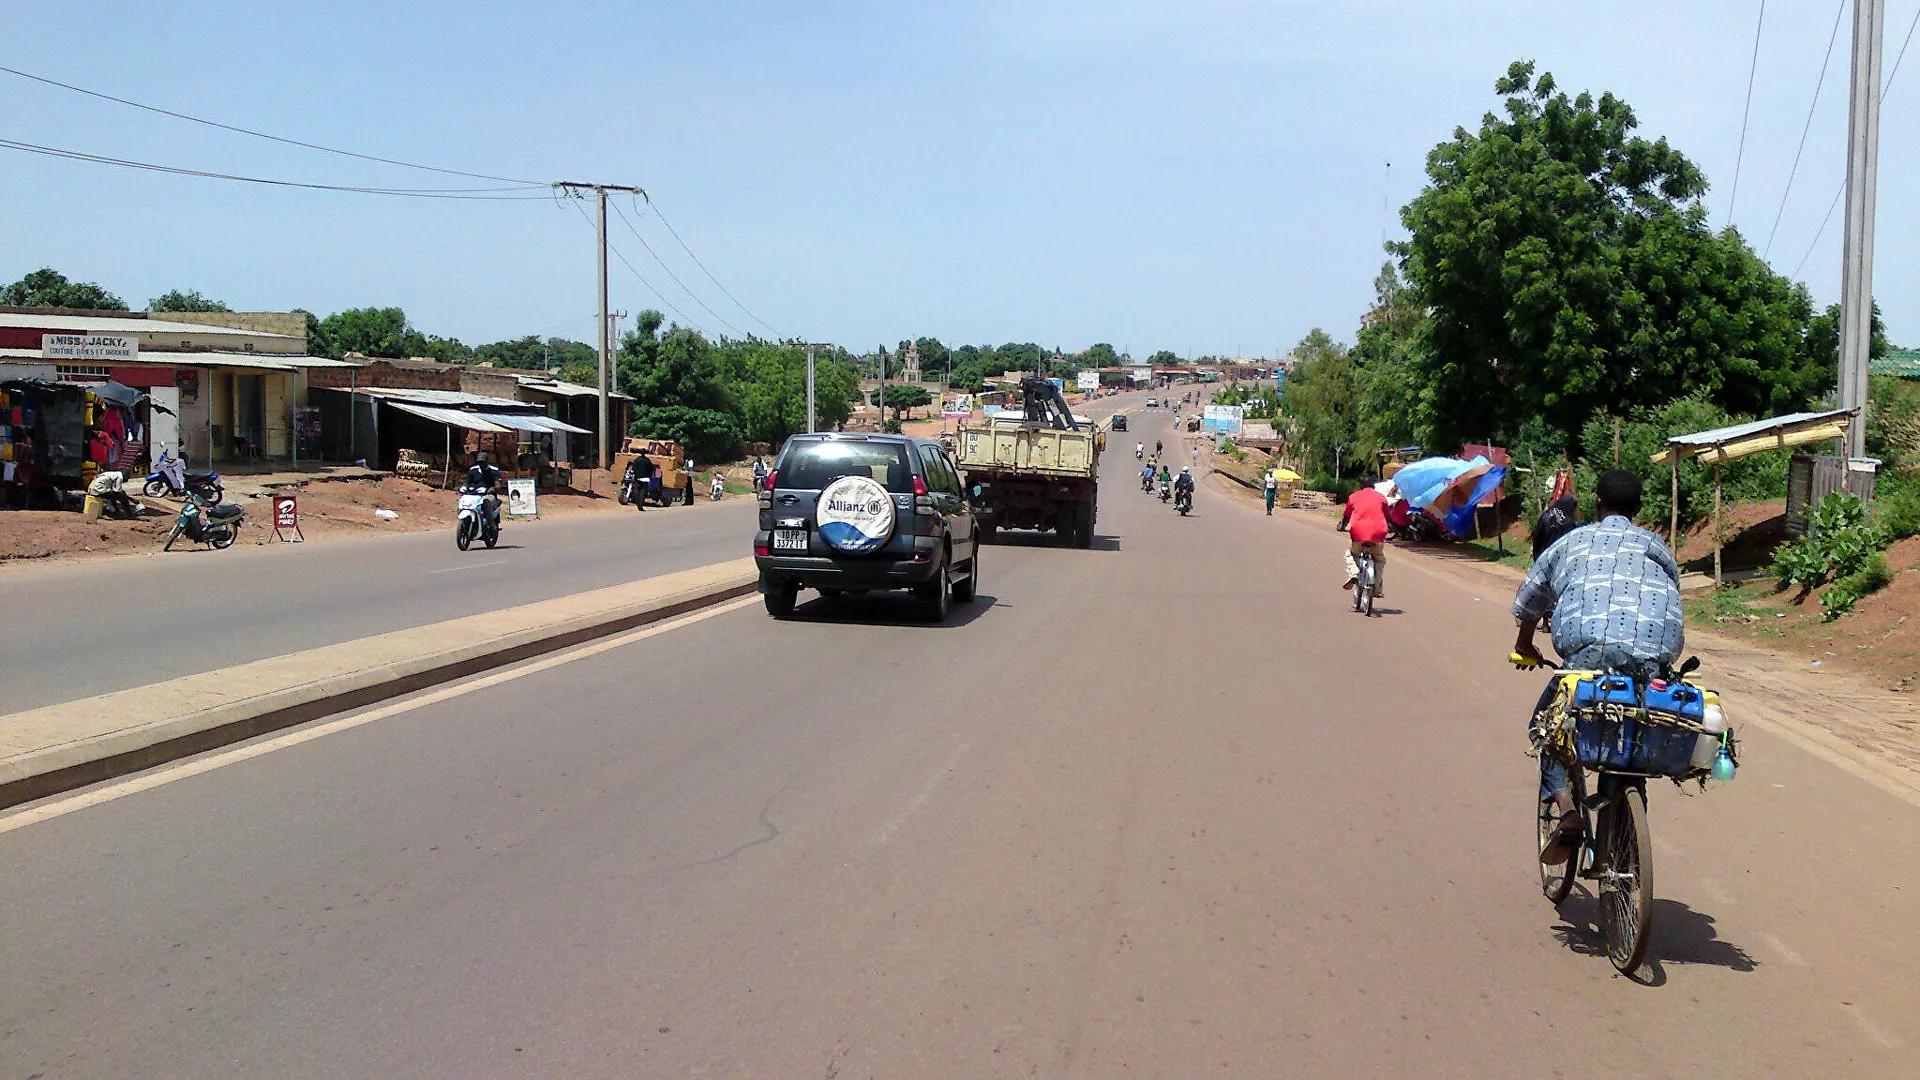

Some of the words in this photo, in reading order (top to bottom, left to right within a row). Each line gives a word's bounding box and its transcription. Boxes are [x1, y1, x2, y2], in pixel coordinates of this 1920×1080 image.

[55, 336, 81, 346] MISS
[88, 337, 123, 347] JACKY
[828, 500, 865, 512] Allianz
